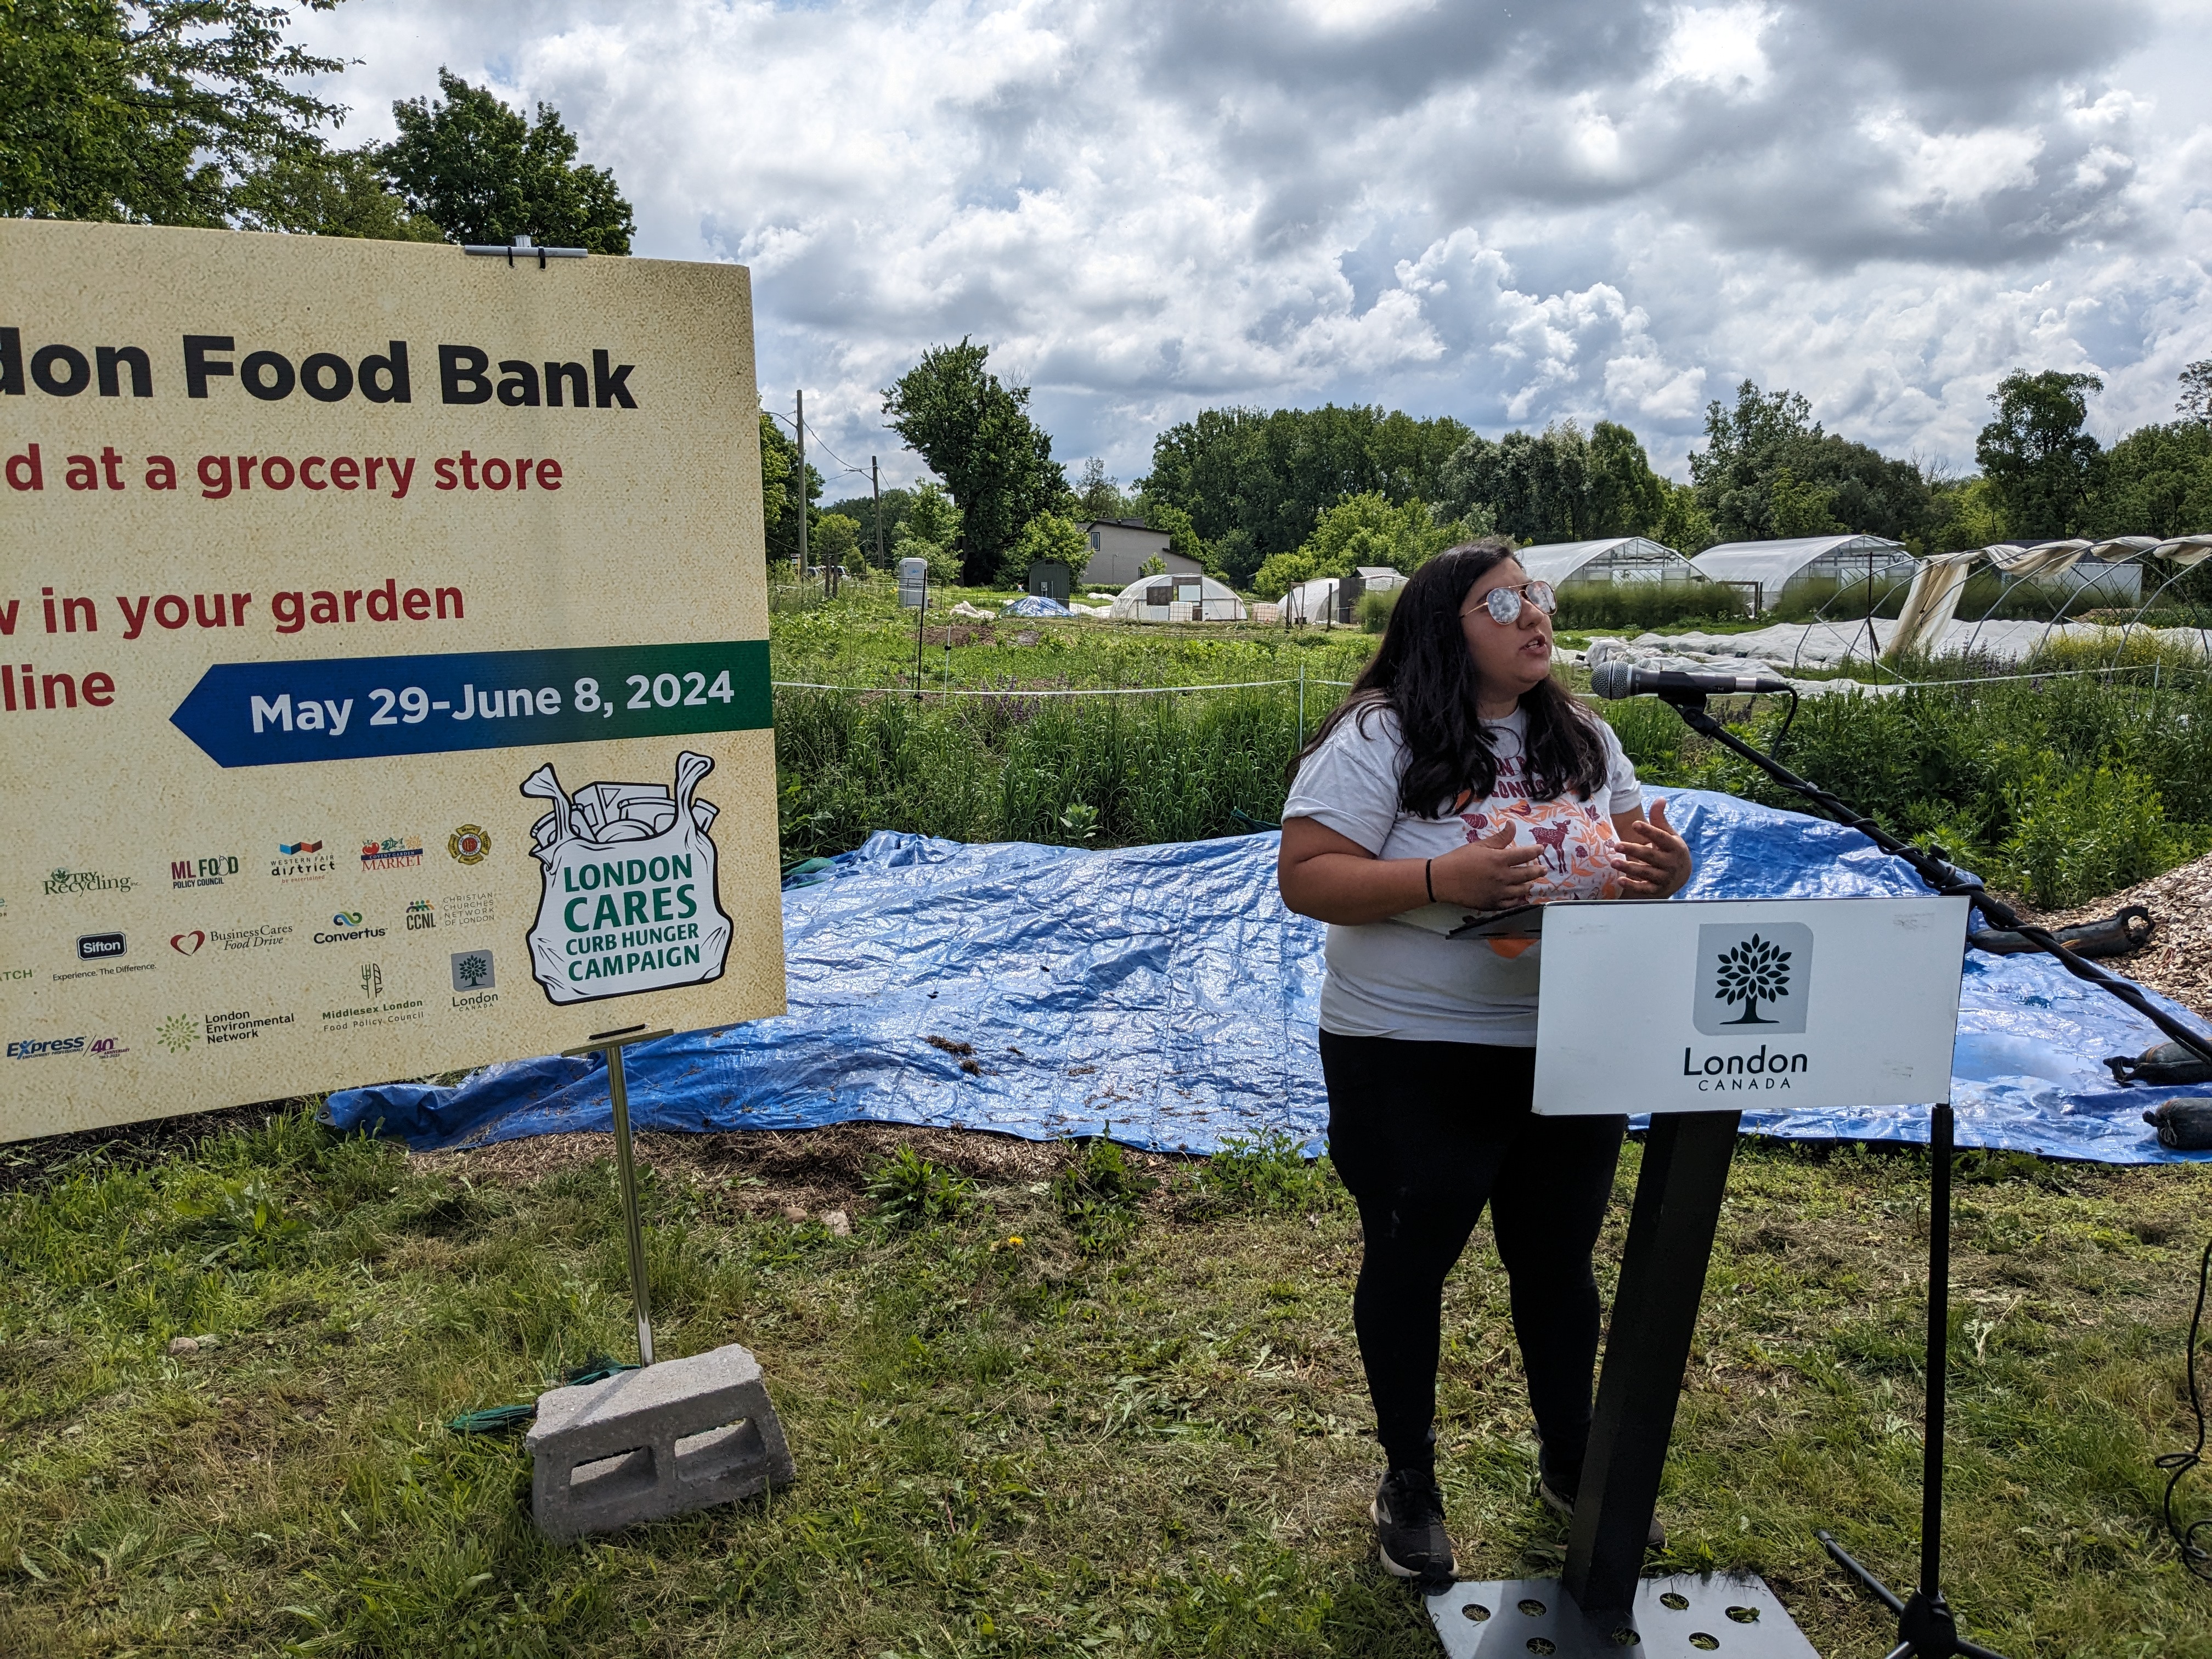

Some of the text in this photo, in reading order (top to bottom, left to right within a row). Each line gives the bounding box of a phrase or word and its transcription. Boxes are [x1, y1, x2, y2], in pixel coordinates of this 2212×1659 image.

[183, 334, 411, 403] Food
[438, 345, 639, 409] Bank
[65, 447, 125, 490] at
[145, 455, 177, 490] a
[197, 455, 416, 499] grocery
[435, 450, 563, 490] store
[42, 587, 98, 633] in
[116, 592, 252, 640] your
[272, 578, 464, 634] garden
[1, 664, 115, 712] line
[250, 670, 735, 736] May 29-June 8, 2024
[171, 861, 196, 879] ML
[270, 856, 311, 866] WESTERN
[271, 861, 335, 876] district
[362, 854, 424, 872] MARKET
[70, 871, 98, 883] TRY
[564, 853, 693, 893] LONDON
[43, 875, 131, 897] Recycling
[173, 877, 224, 889] POLICY COUNCIL
[443, 892, 493, 903] CHRISTIAN
[443, 899, 494, 911] CHURCHES
[444, 907, 494, 919] NETWORK
[564, 884, 697, 933] CARES
[406, 912, 436, 930] CCNL
[459, 915, 494, 924] LONDON
[223, 935, 284, 950] Food Drive
[313, 928, 386, 944] Convertus
[566, 923, 699, 956] CURB HUNGER
[83, 941, 121, 953] Sifton
[568, 944, 701, 981] CAMPAIGN
[0, 969, 32, 981] TCH
[53, 971, 98, 981] Experience.
[116, 963, 157, 973] Difference.
[452, 992, 498, 1007] London
[459, 1002, 494, 1012] CANADA
[205, 1011, 250, 1024] London
[322, 999, 423, 1020] Middlesex London
[206, 1012, 295, 1034] Environmental
[324, 1011, 424, 1031] Food Policy Council
[207, 1029, 259, 1044] Network
[1683, 1044, 1808, 1075] London
[1698, 1077, 1791, 1091] CANADA
